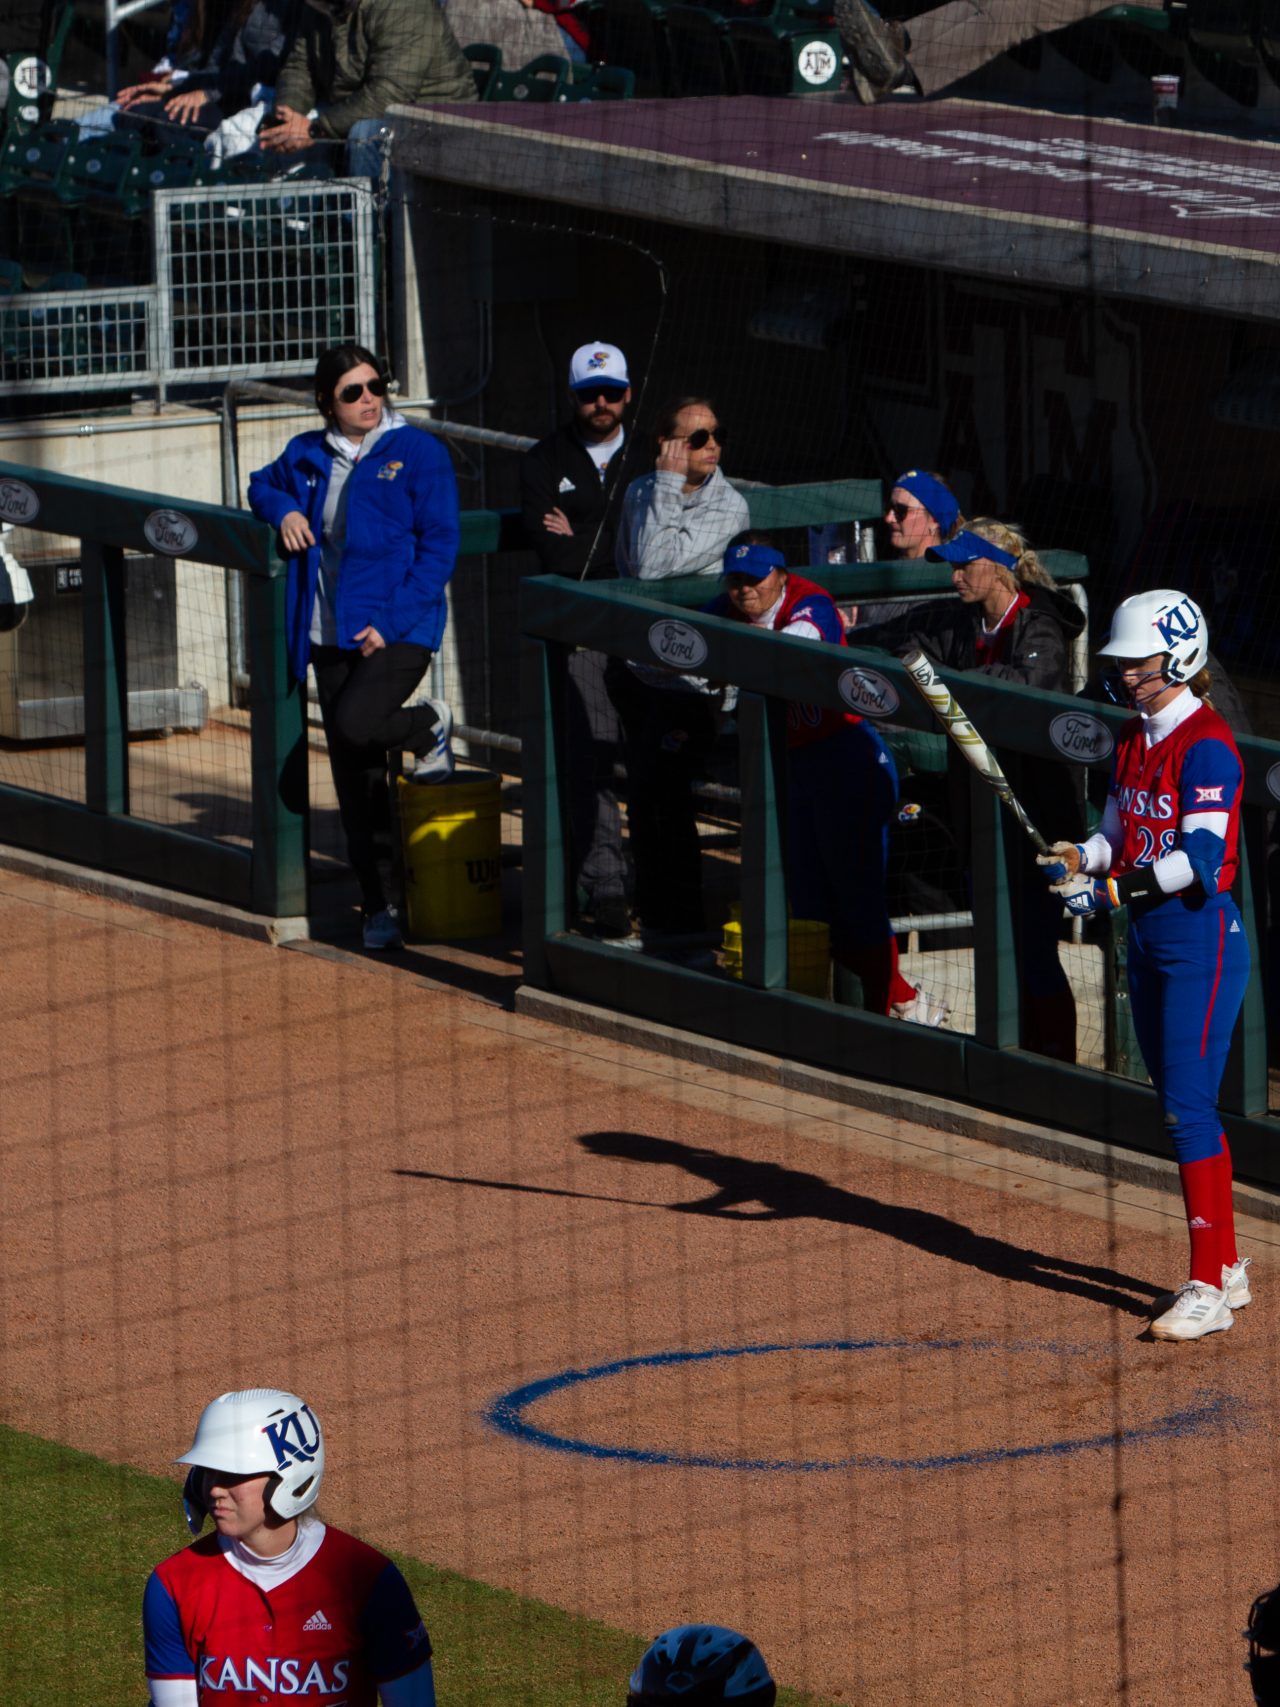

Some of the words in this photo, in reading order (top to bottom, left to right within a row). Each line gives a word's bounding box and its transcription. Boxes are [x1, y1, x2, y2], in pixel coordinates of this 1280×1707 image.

[1152, 598, 1201, 650] KU
[1061, 718, 1102, 755] Ford
[261, 1404, 320, 1471] KU
[302, 1621, 332, 1631] adidas
[200, 1655, 350, 1695] KANSAS
